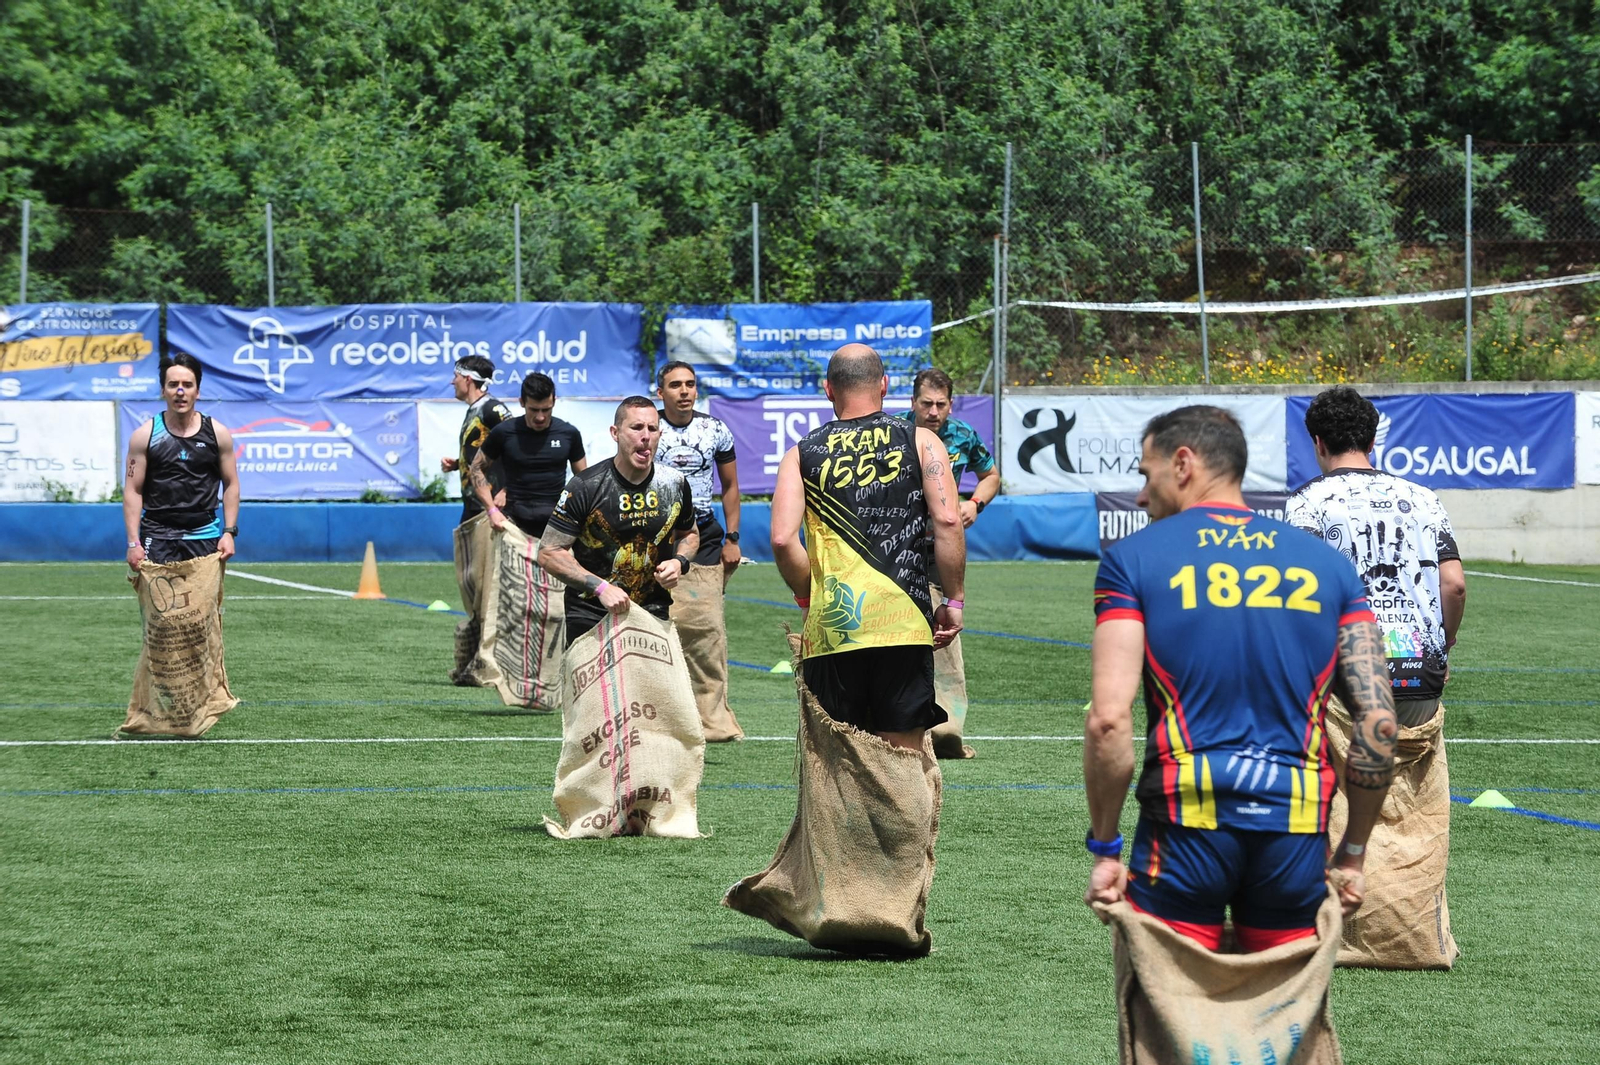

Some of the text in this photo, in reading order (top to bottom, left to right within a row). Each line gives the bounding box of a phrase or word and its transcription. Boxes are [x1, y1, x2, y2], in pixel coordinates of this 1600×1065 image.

[40, 307, 113, 318] SERVICIOS
[333, 314, 452, 329] HOSPITAL
[740, 323, 923, 344] Empresa Nieto
[52, 332, 145, 374] Iglesias
[329, 330, 587, 366] recoletos salud
[492, 368, 588, 384] CAEN
[246, 442, 353, 459] MOTOR
[826, 425, 891, 454] FRAN
[820, 450, 903, 492] 1553
[618, 490, 659, 511] 836
[857, 506, 911, 518] PERSEVERA
[867, 522, 892, 536] HAZ
[1197, 525, 1278, 550] IVÁN
[1169, 562, 1321, 614] 1822
[581, 701, 657, 755] EXCELSO
[599, 727, 641, 769] CAFÉ
[581, 785, 672, 830] COLOMBIA
